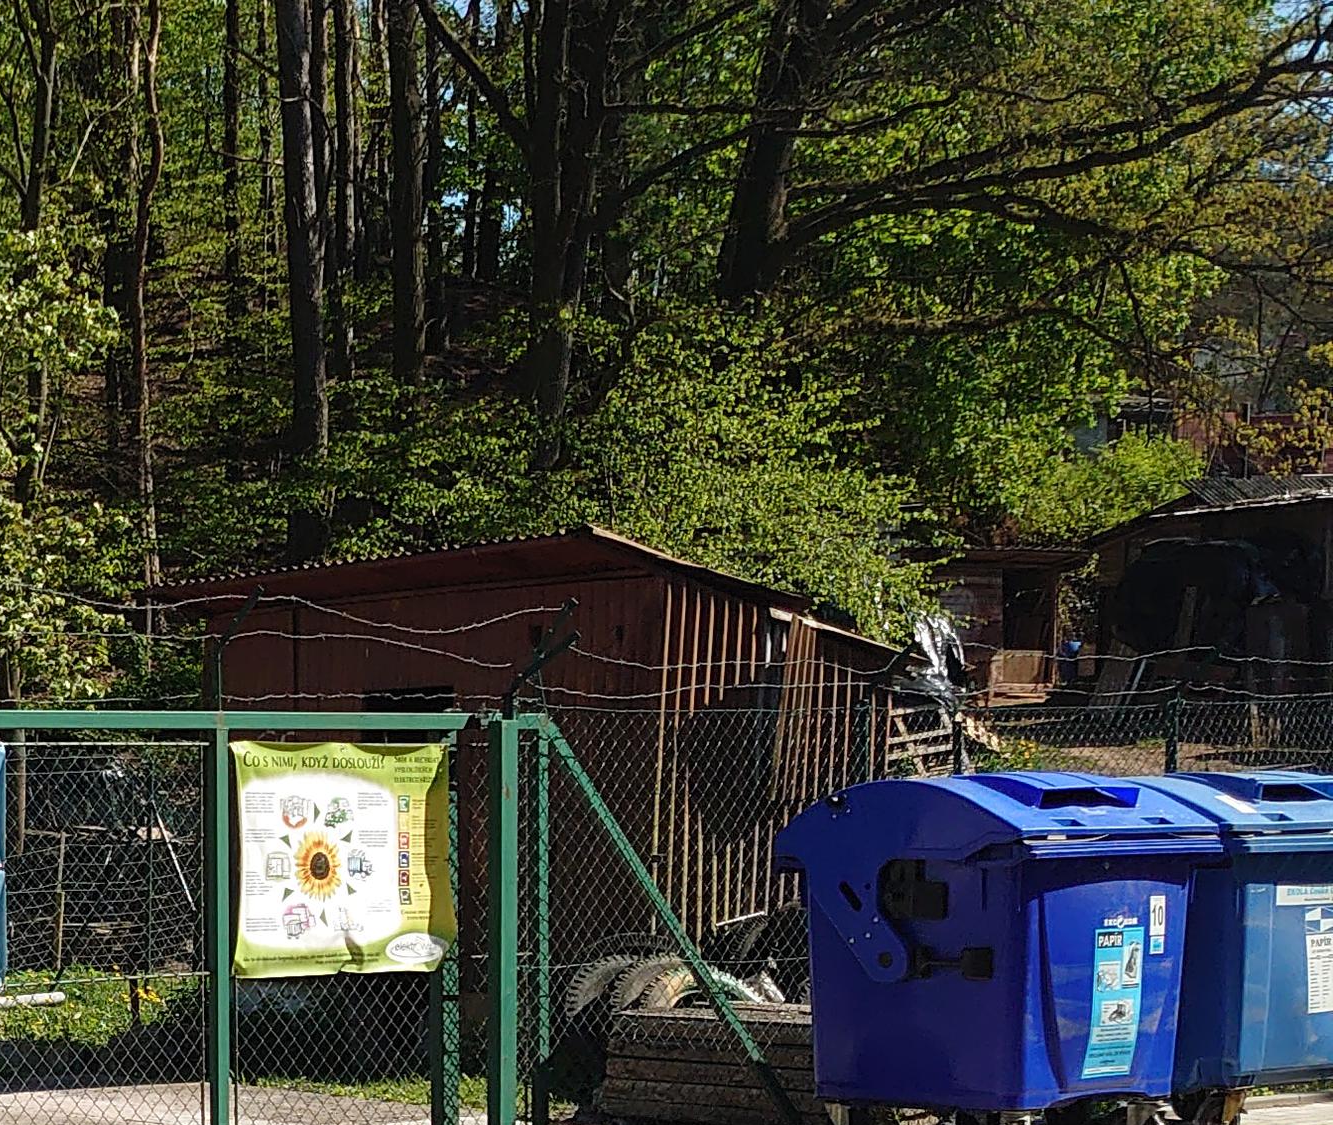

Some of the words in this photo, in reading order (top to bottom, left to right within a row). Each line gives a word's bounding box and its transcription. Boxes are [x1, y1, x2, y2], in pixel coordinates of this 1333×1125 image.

[301, 755, 328, 768] KDYŽ
[332, 754, 386, 769] DOSLOUŽÍ?
[1152, 904, 1164, 927] 10
[1098, 932, 1123, 947] PAPÍR
[1311, 936, 1332, 947] PAPÍR
